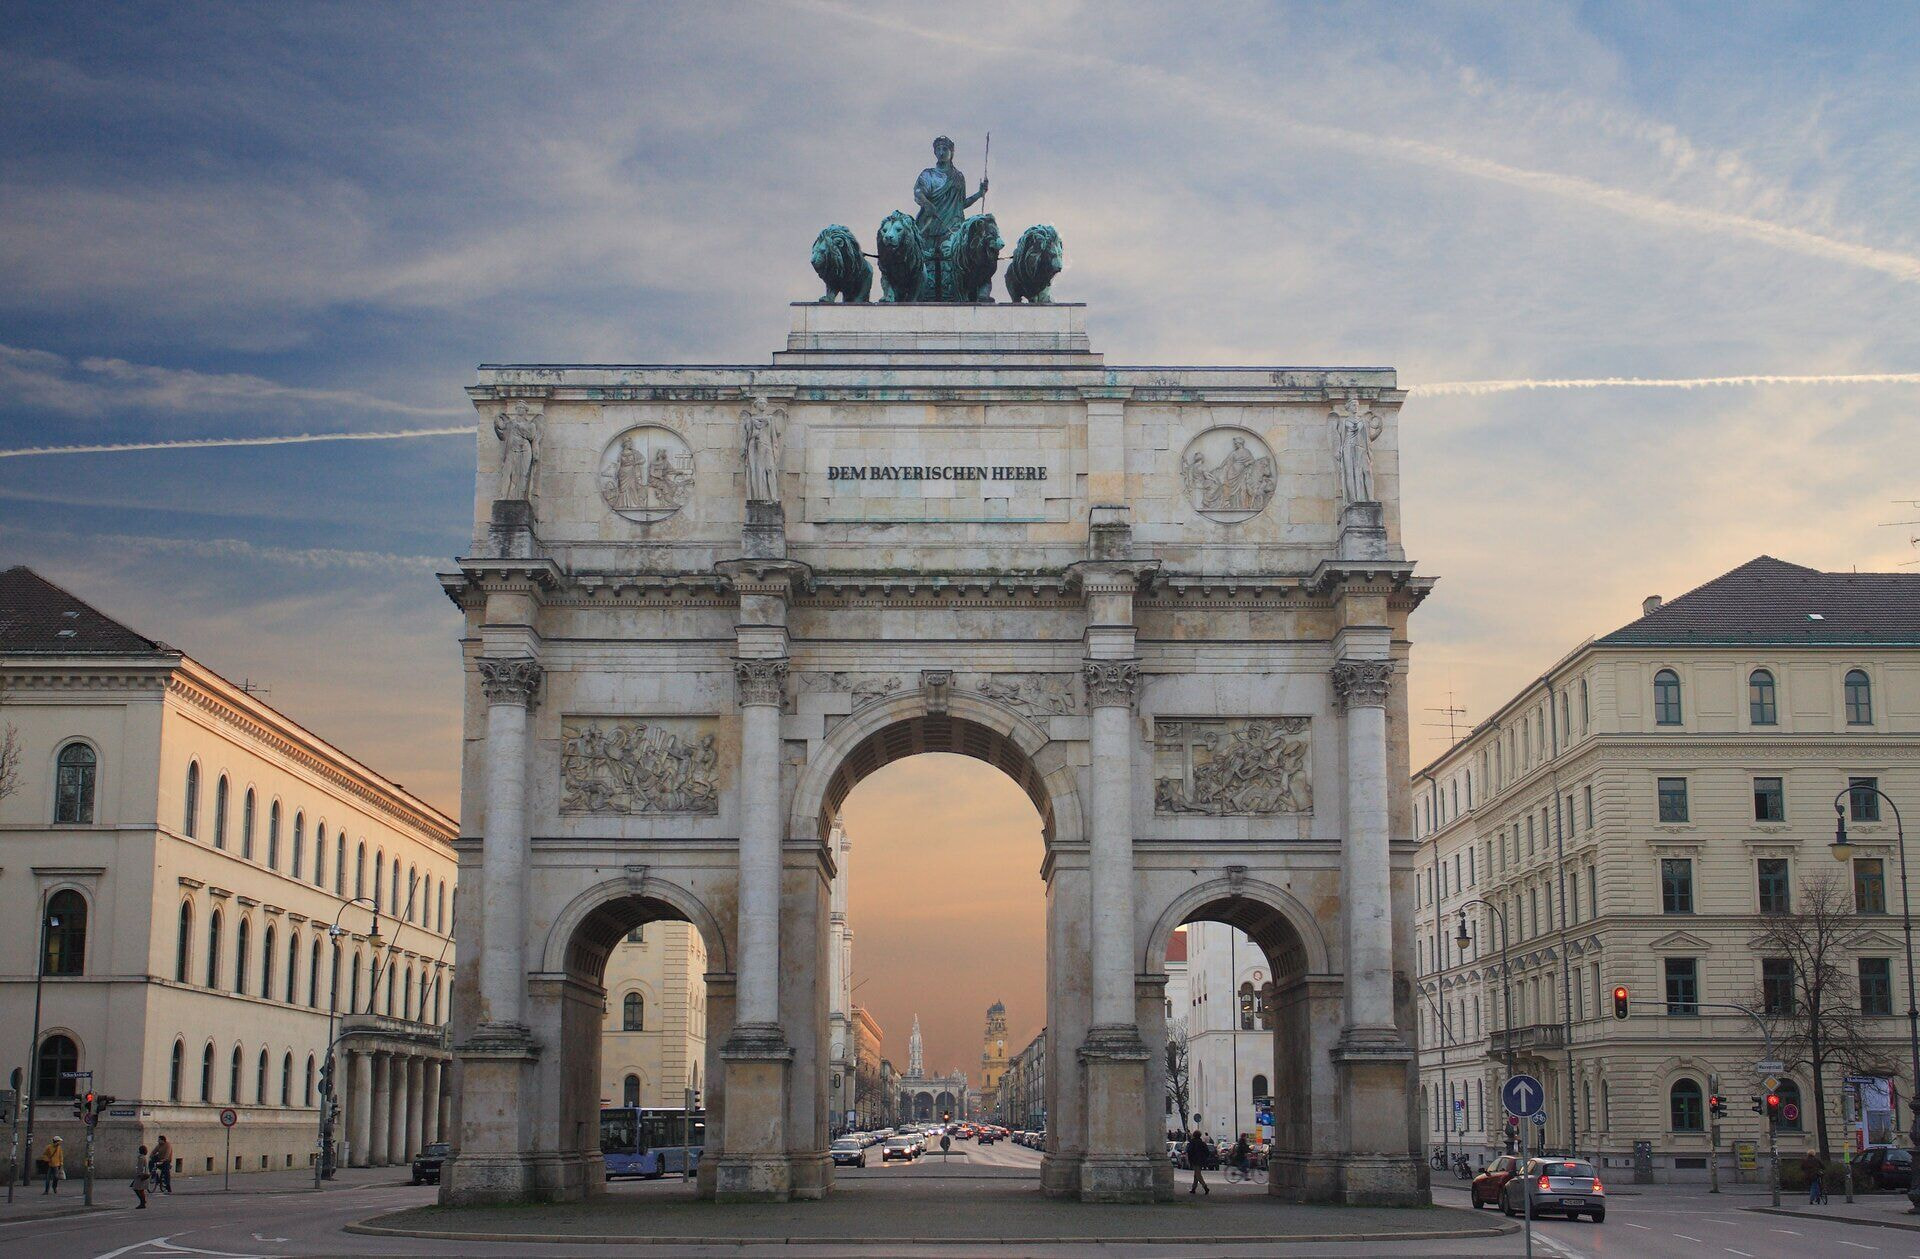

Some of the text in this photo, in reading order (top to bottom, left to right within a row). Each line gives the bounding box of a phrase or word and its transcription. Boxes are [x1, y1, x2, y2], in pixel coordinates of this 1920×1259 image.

[828, 466, 1048, 480] DEM BAYERISCHEN HEERE
